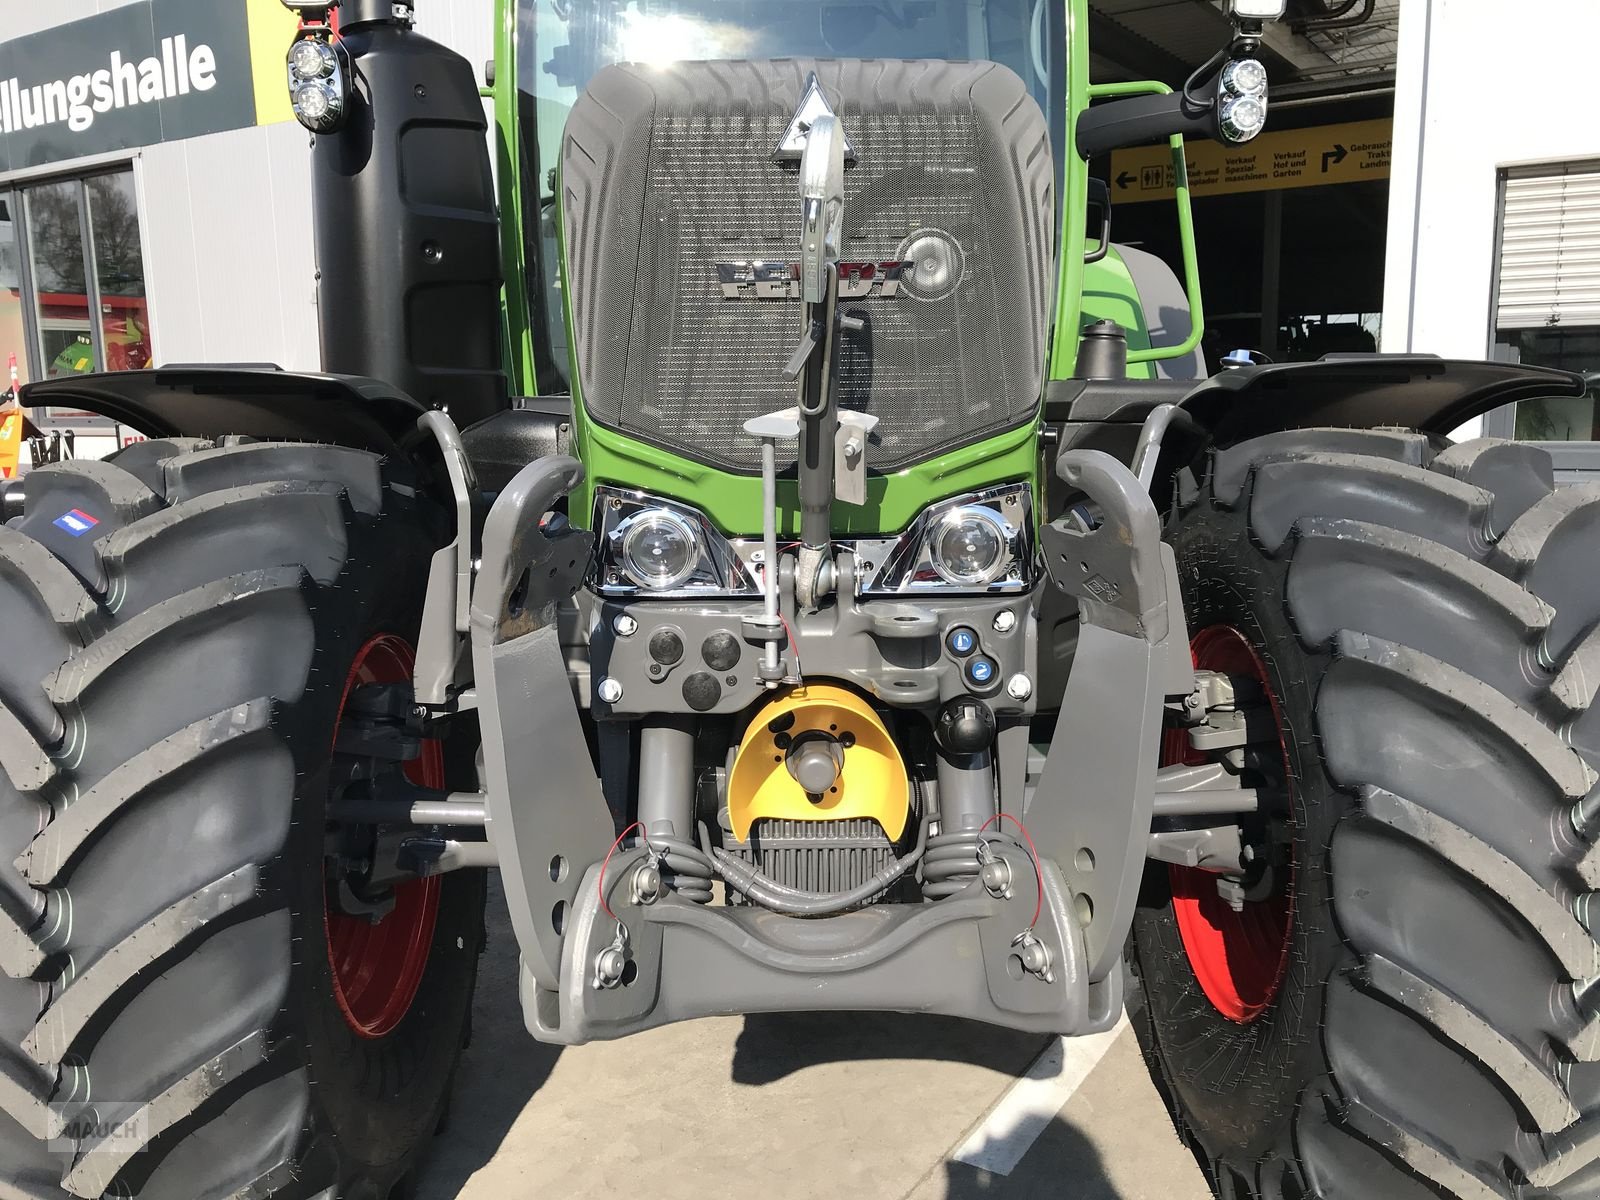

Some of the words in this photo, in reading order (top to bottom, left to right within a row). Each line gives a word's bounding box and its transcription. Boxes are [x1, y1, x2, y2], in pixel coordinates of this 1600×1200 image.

[0, 34, 216, 133] llungshalle
[1225, 155, 1256, 165] Verkauf
[1274, 150, 1306, 160] Verkauf
[1367, 151, 1391, 159] Trakt
[1273, 161, 1288, 169] Hof
[1290, 159, 1306, 168] und
[1225, 165, 1257, 175] Spezial-
[1273, 169, 1302, 178] Garten
[1225, 172, 1268, 183] maschinen
